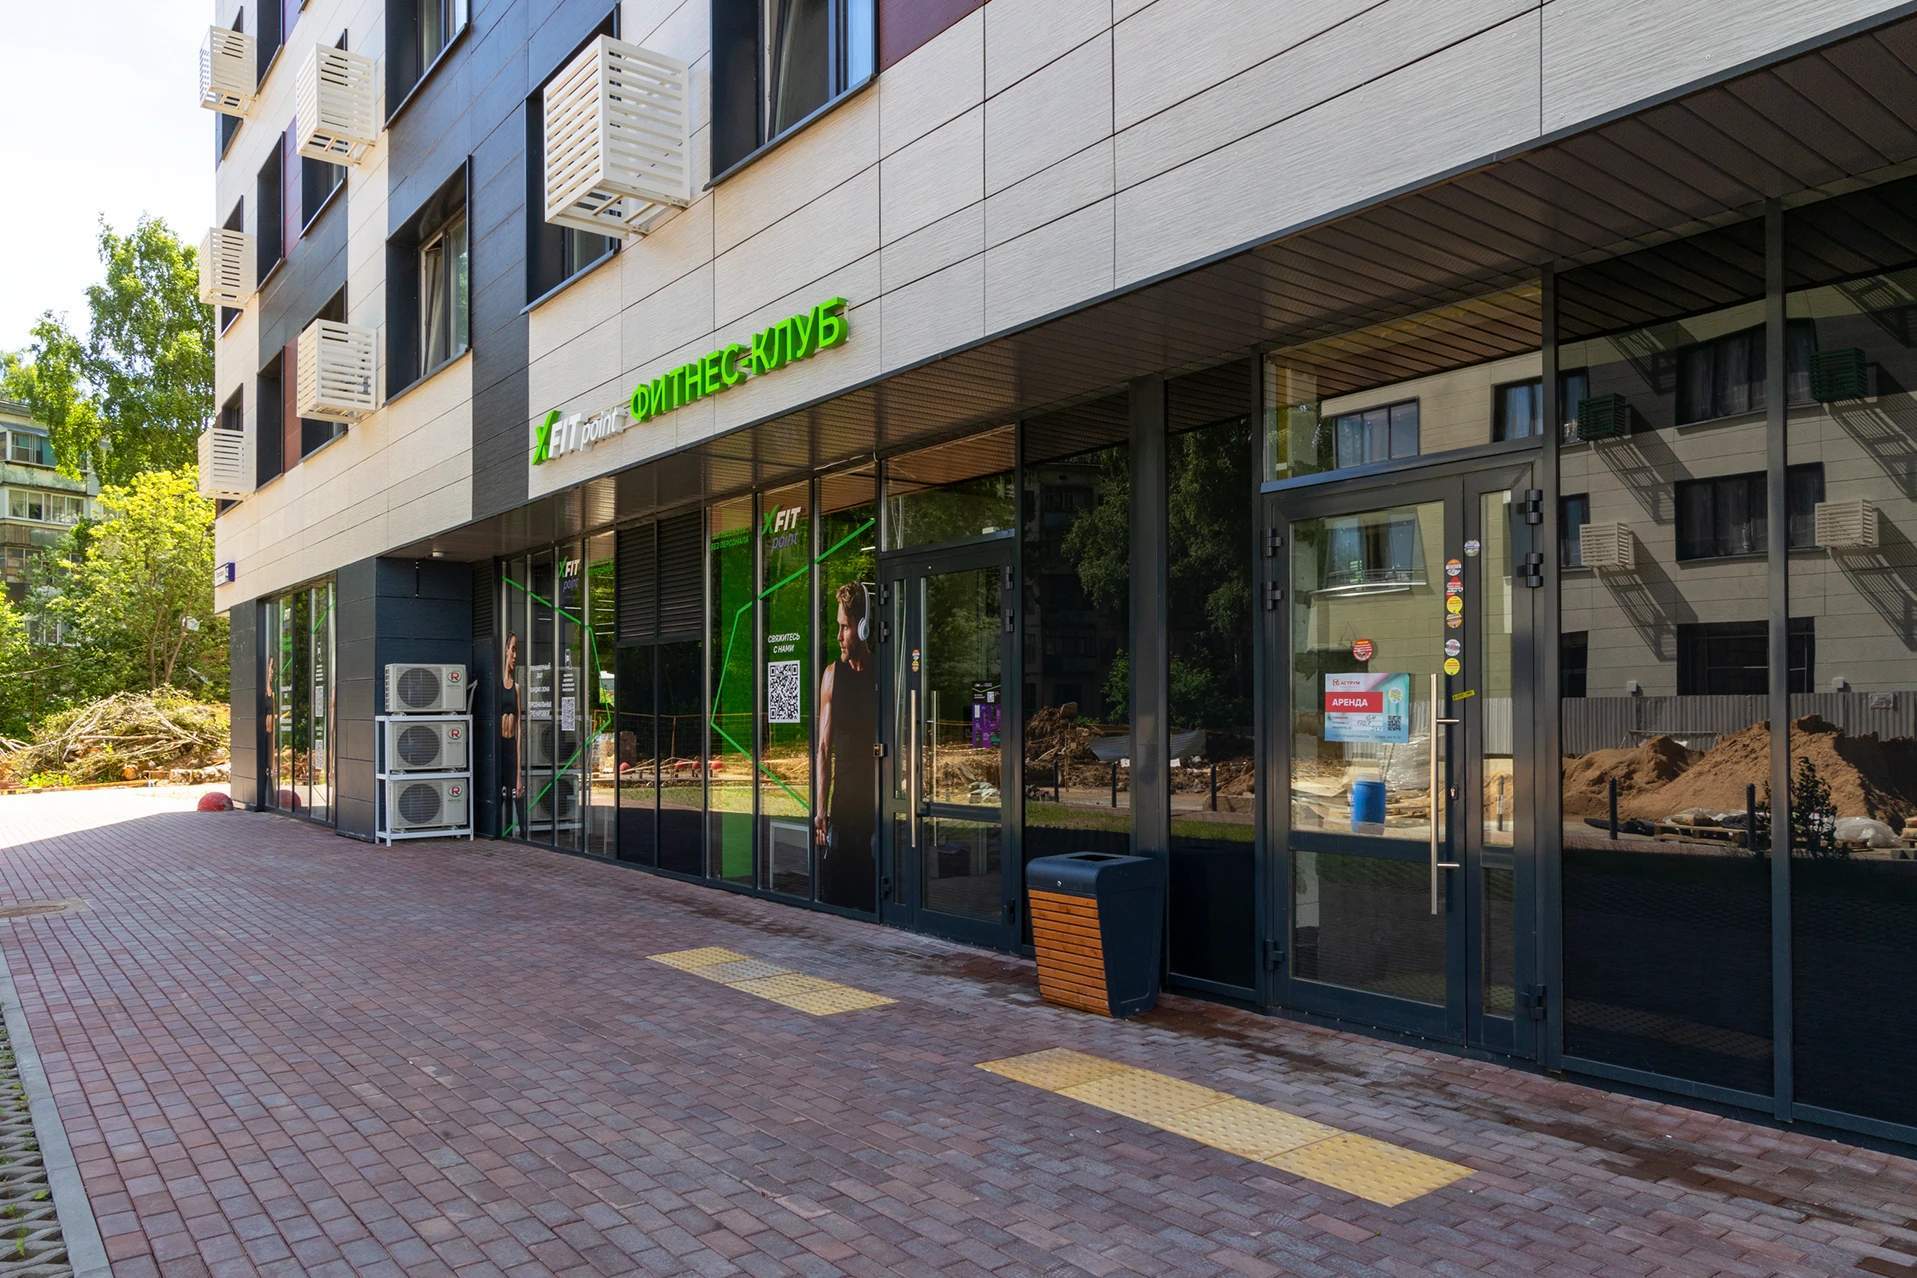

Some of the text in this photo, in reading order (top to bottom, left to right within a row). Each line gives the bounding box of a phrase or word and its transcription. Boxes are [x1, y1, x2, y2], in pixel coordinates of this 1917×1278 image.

[630, 296, 849, 422] ФИТНЕС-КЛУБ
[581, 407, 626, 446] point
[767, 632, 801, 643] СВЯЖИТЕСЬ
[1332, 698, 1369, 708] АРЕНДА
